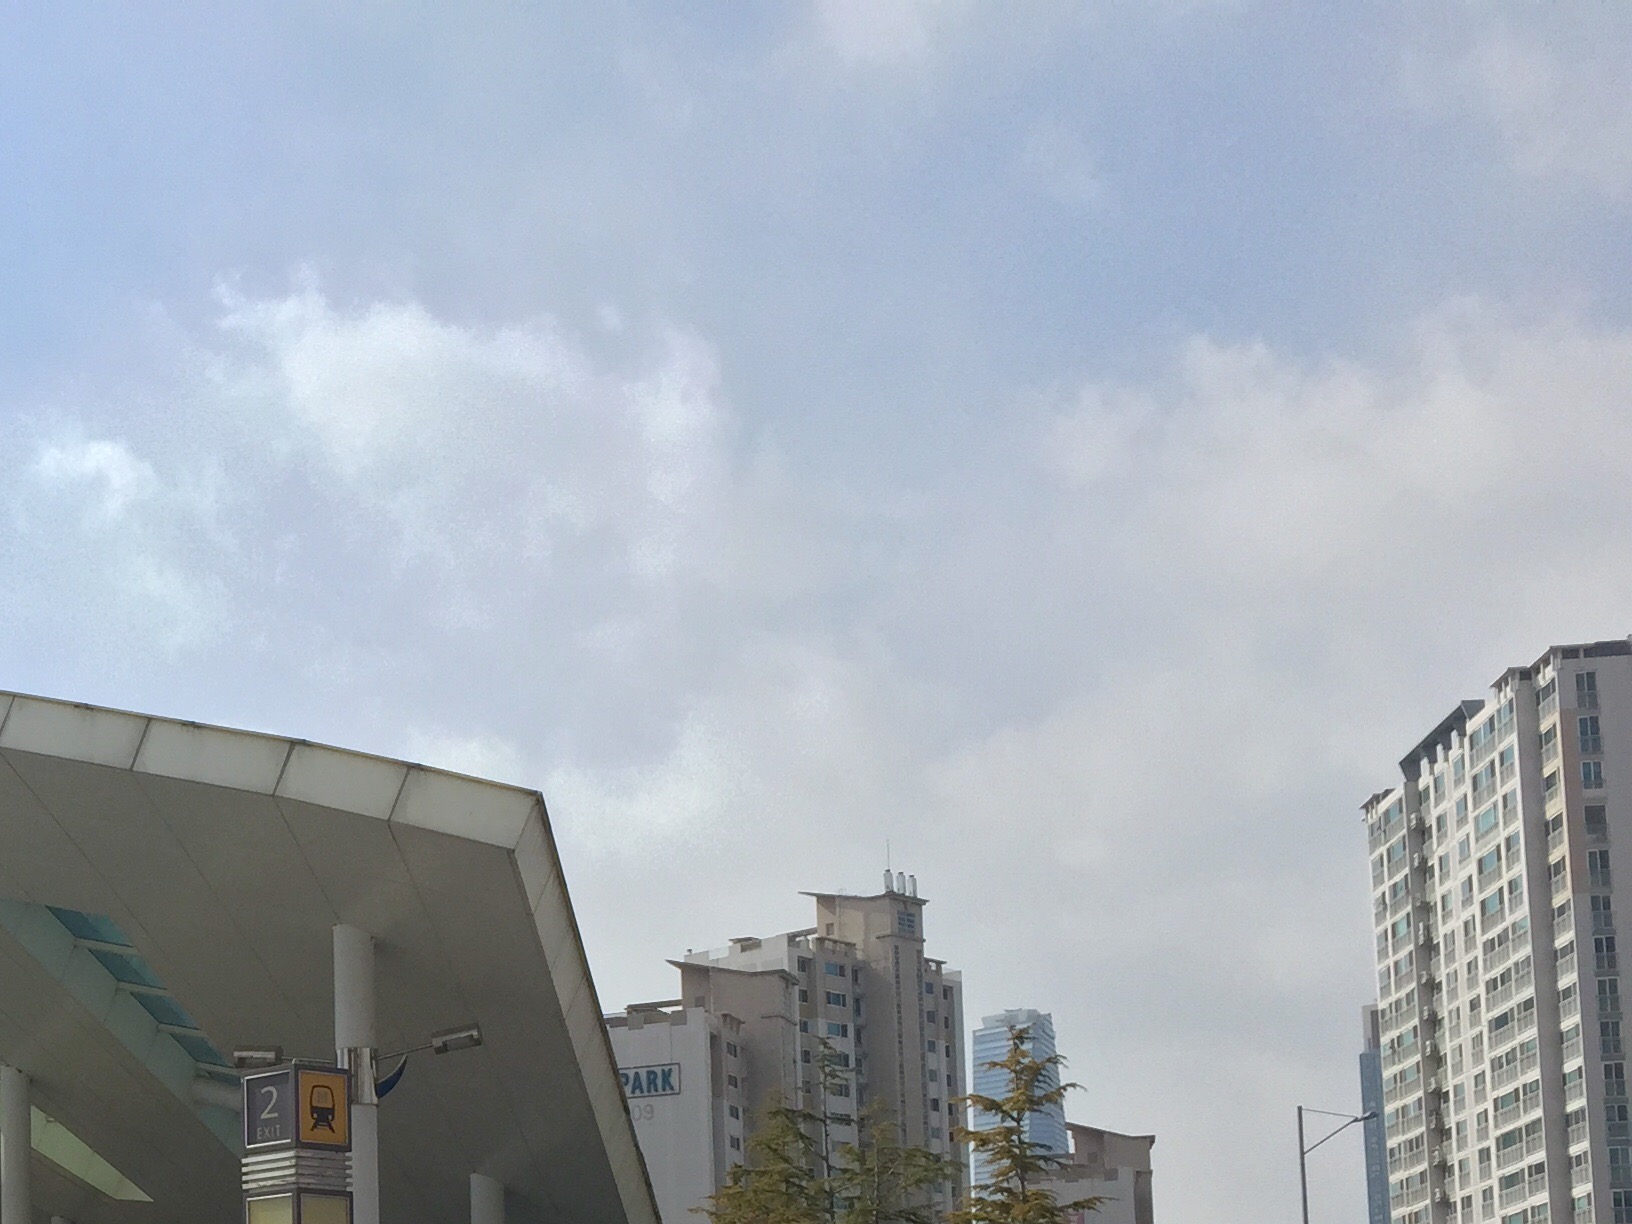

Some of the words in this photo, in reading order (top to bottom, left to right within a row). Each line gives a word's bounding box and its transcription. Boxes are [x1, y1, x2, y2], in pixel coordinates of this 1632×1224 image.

[619, 1068, 674, 1095] PARK
[260, 1085, 279, 1120] 2
[256, 1124, 281, 1140] EXIT
